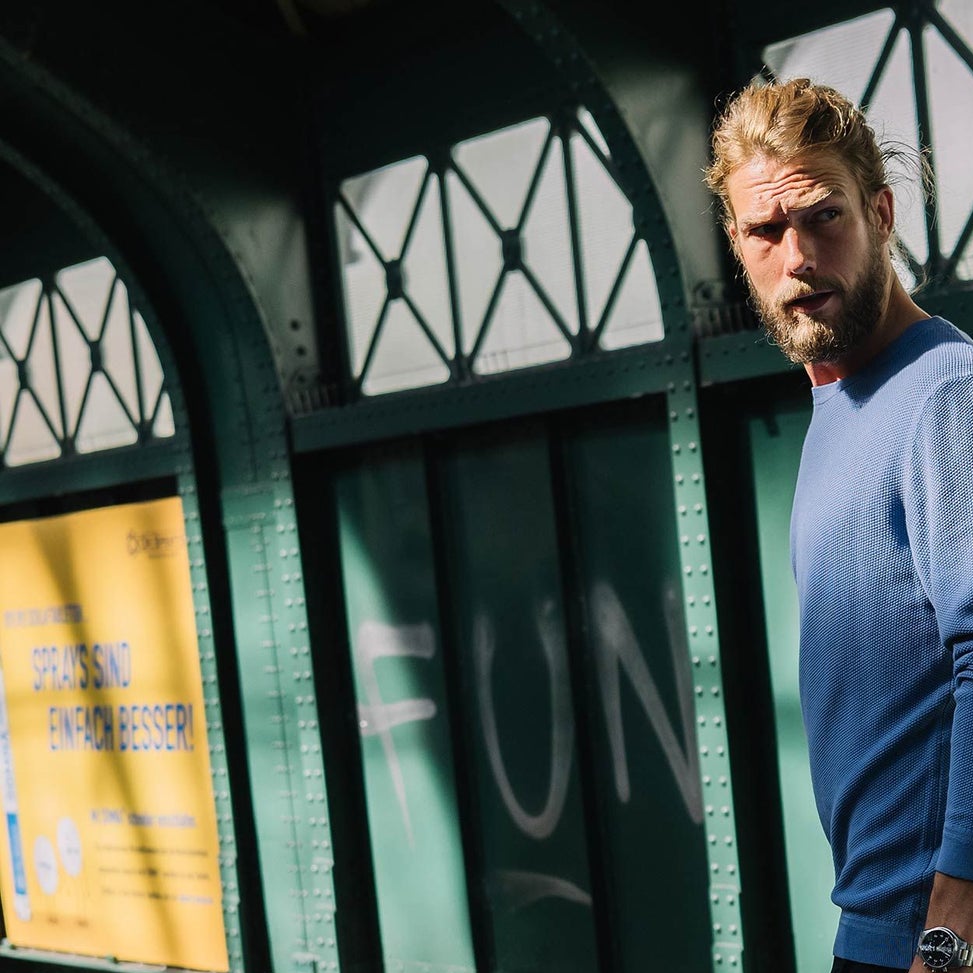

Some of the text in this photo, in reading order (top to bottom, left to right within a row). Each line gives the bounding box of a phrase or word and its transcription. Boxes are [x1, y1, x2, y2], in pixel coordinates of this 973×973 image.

[33, 641, 131, 690] SPRAYS SIND
[49, 703, 194, 752] EINFACH BESSER!
